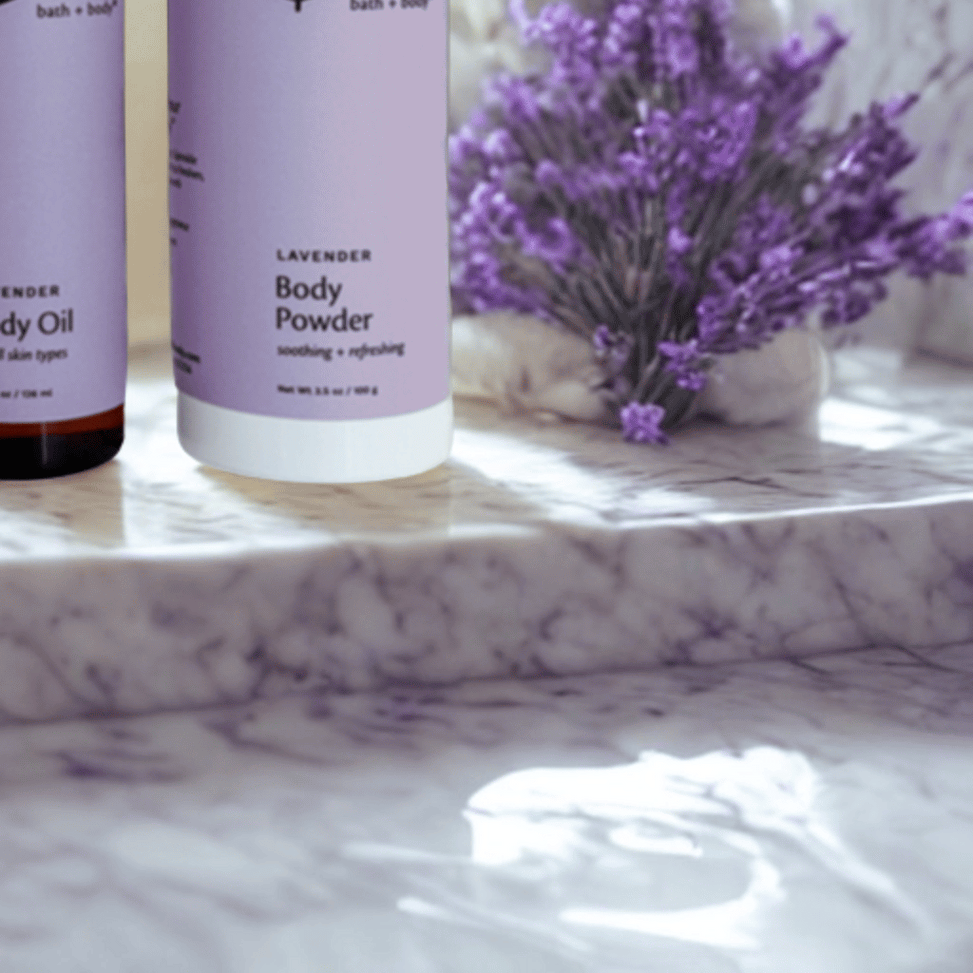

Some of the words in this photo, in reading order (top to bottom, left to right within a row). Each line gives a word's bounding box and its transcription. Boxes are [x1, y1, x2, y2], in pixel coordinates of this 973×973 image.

[36, 3, 70, 19] bath
[276, 249, 371, 263] LAVENDER
[276, 275, 342, 307] Body
[37, 308, 74, 336] Oil
[276, 306, 374, 332] Powder
[277, 343, 333, 361] soothing
[348, 342, 406, 361] refreshing
